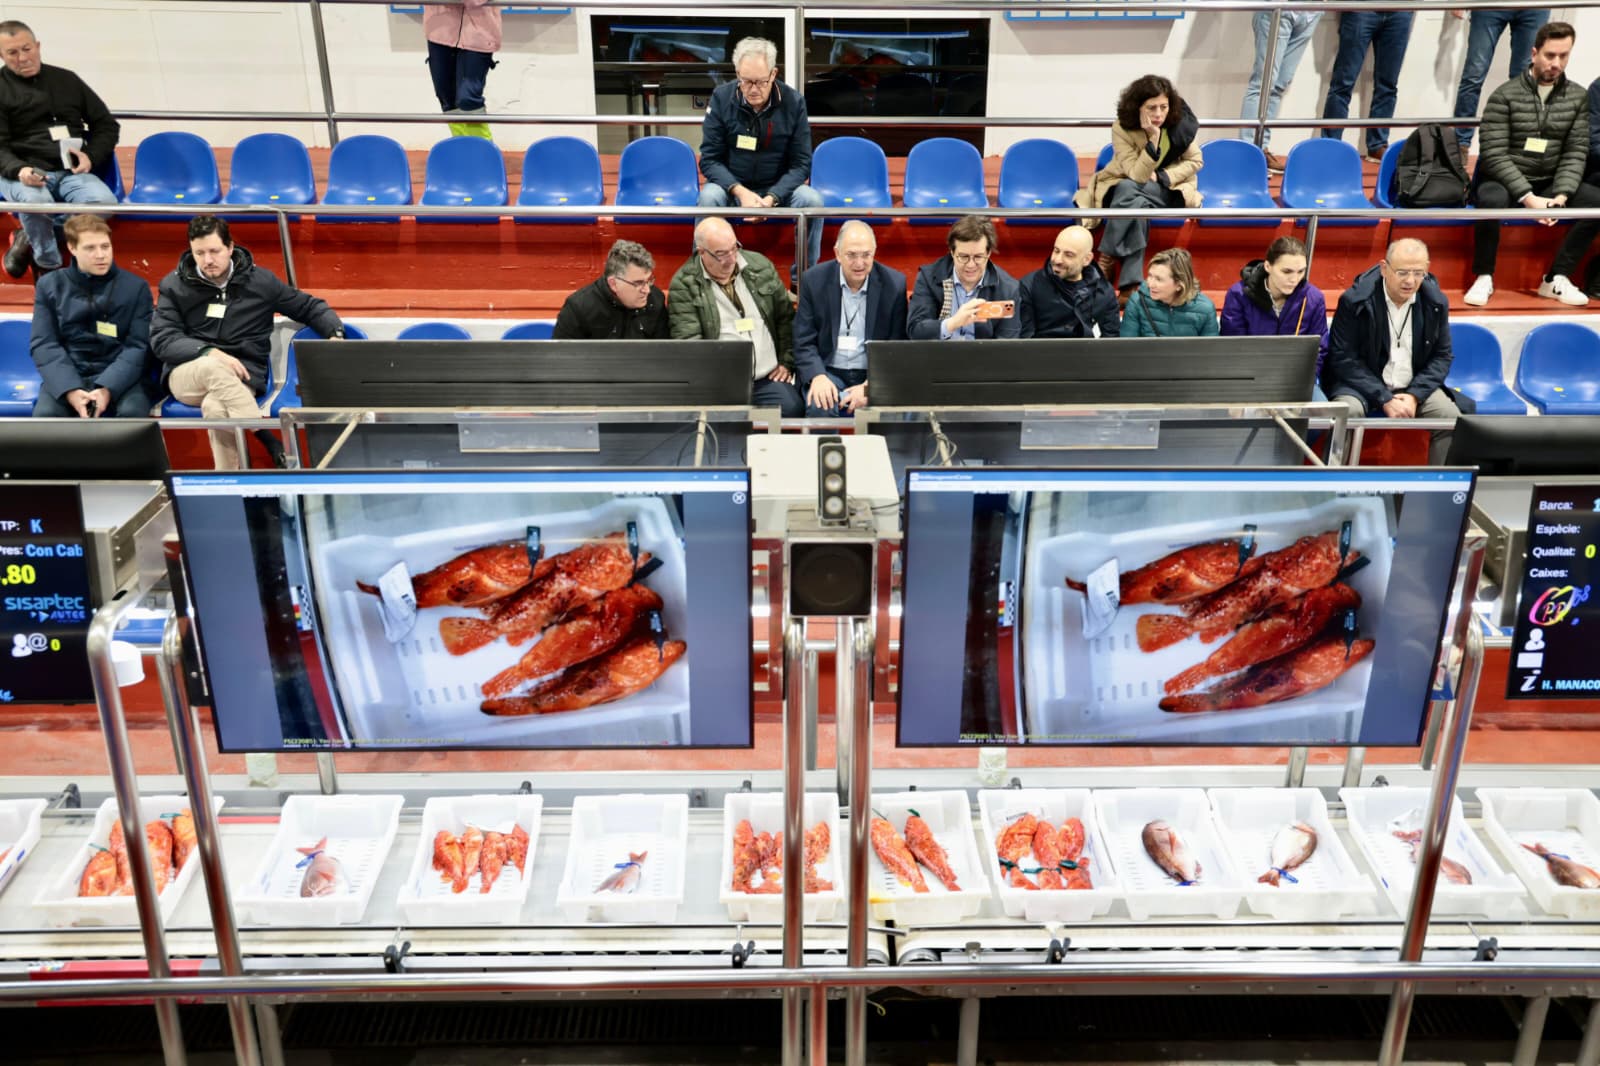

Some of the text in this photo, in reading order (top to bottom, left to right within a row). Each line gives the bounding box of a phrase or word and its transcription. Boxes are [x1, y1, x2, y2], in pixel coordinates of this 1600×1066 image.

[1539, 500, 1573, 511] Barca:
[30, 518, 43, 533] K
[1536, 523, 1581, 536] Espècie:
[0, 543, 83, 557] res: Con Cab
[1532, 544, 1596, 558] Qualitat: 0
[0, 564, 36, 586] .80
[1529, 568, 1569, 578] Caixes:
[50, 638, 61, 652] 0
[1542, 679, 1553, 690] H.
